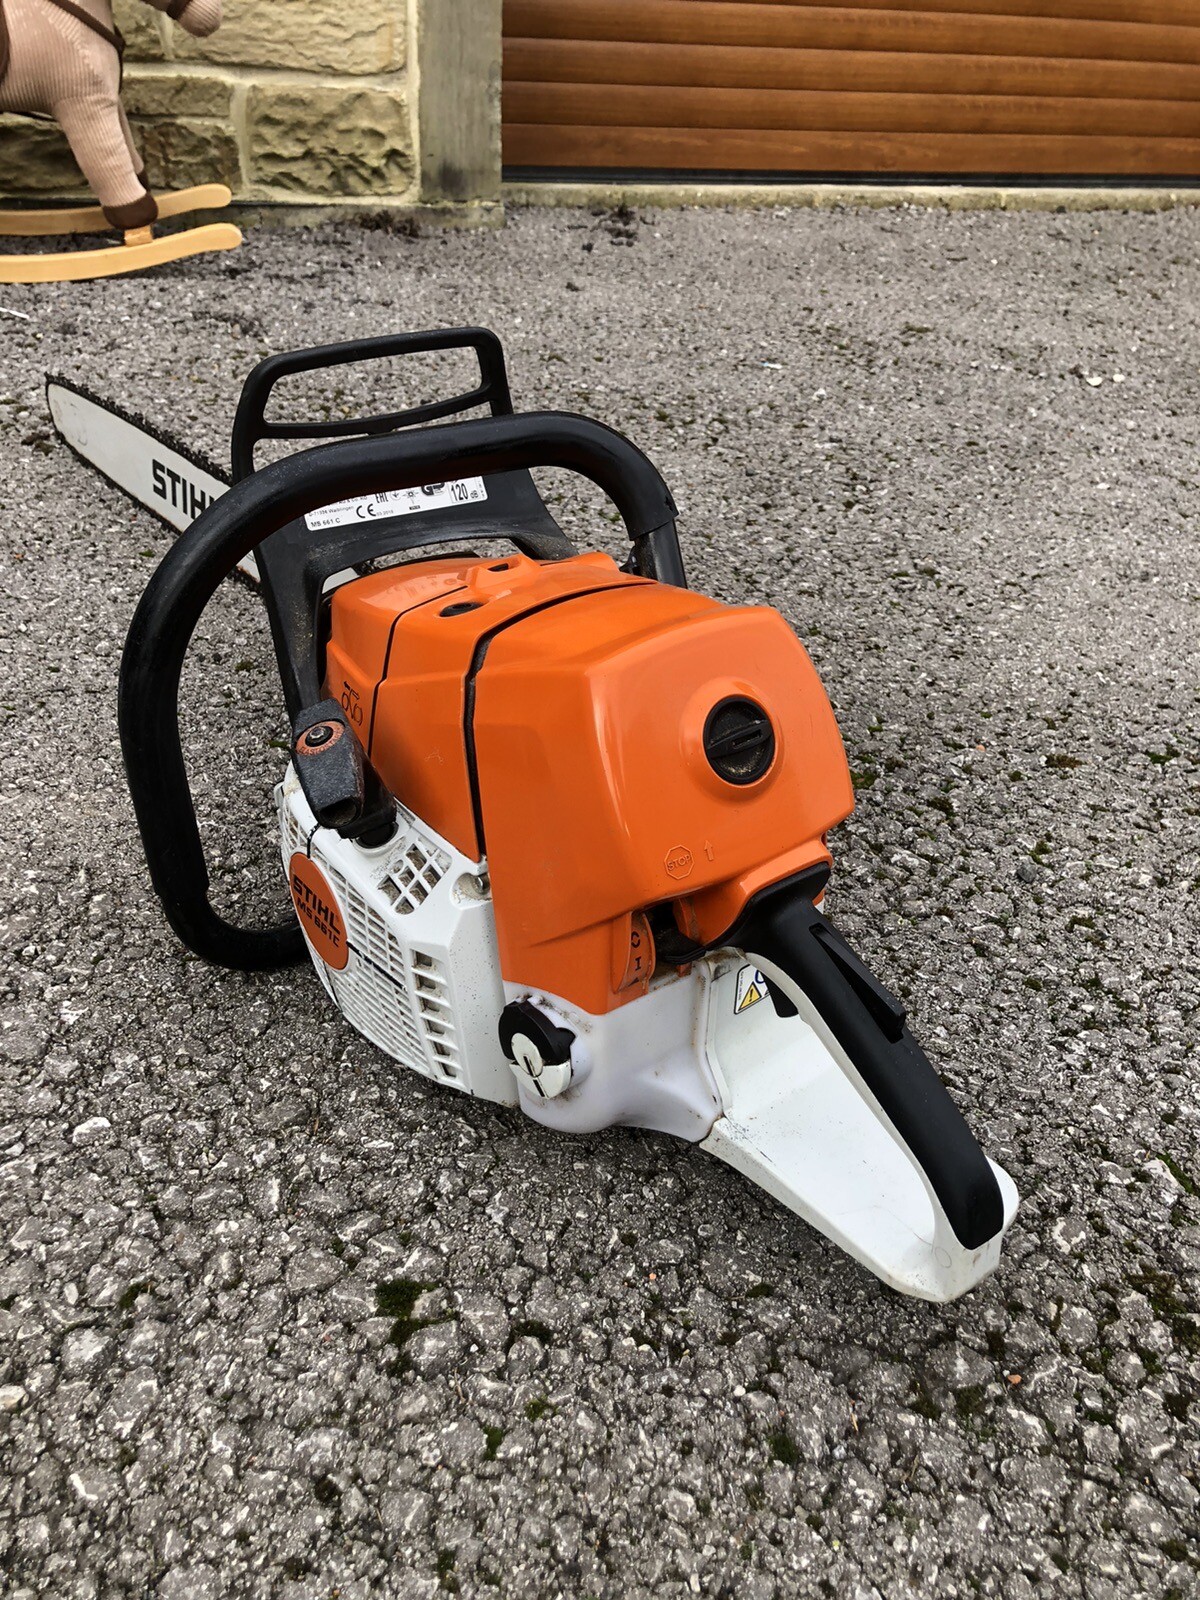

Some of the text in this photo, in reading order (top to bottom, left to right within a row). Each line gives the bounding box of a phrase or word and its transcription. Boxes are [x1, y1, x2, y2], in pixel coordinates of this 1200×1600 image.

[152, 459, 215, 520] STIH
[451, 483, 468, 501] 120
[356, 503, 376, 518] CE
[310, 520, 321, 528] MS
[667, 854, 690, 871] STOP
[293, 874, 341, 935] STIHL
[297, 896, 313, 920] MS
